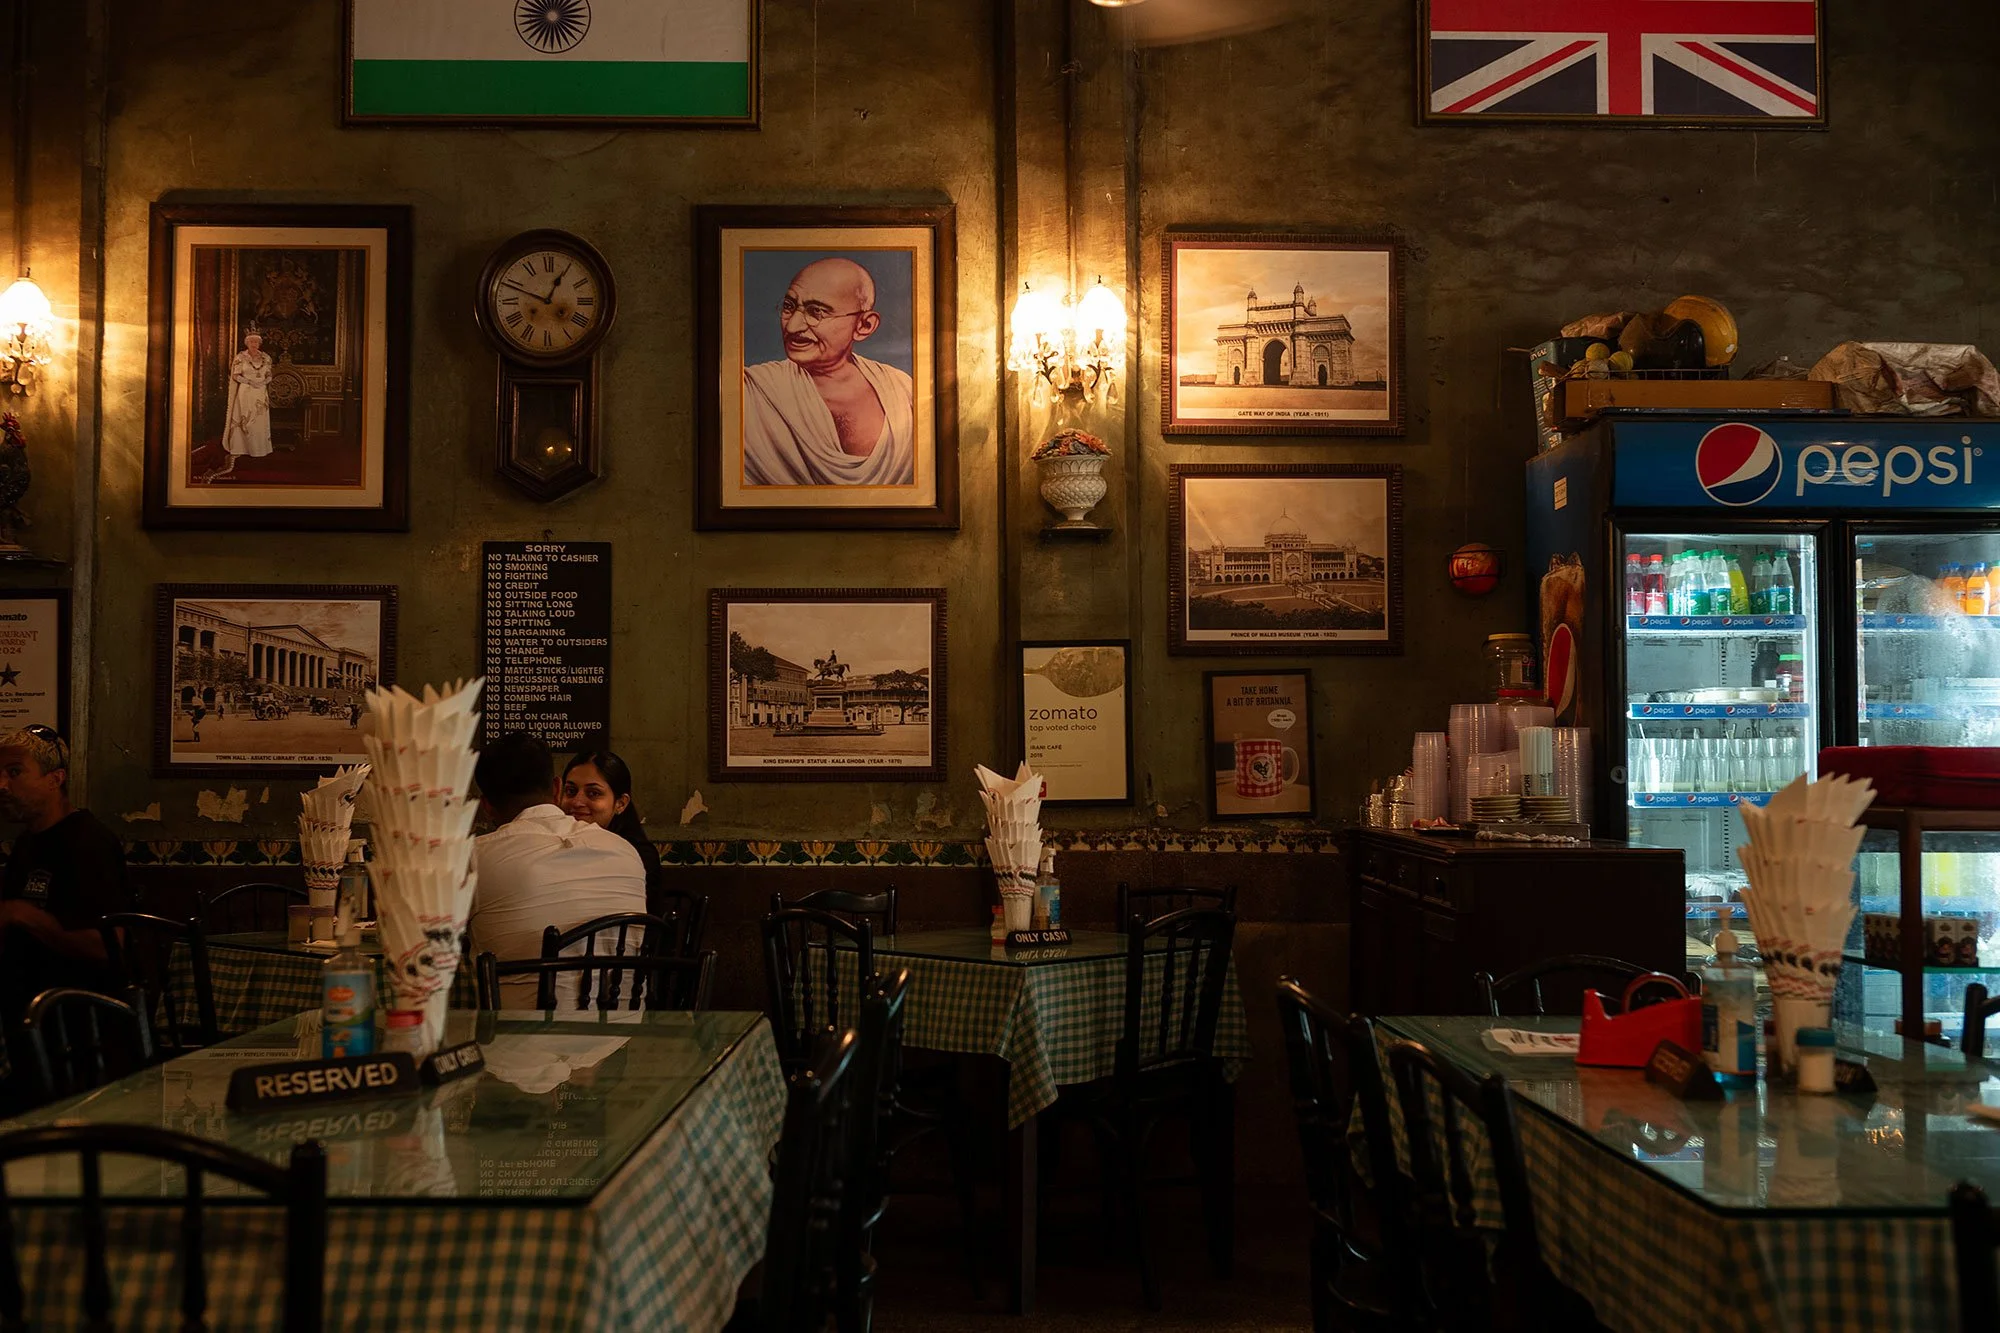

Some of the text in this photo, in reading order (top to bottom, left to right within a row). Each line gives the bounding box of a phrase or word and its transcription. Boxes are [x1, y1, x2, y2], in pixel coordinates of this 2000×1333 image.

[1796, 436, 1972, 497] pepsi
[536, 666, 604, 674] STICKS/LIGHTER
[1259, 686, 1278, 694] HOME
[1234, 698, 1243, 706] BIT
[1030, 706, 1097, 720] zomato
[1015, 931, 1068, 942] ONLY CASH
[255, 1062, 399, 1099] RESERVED
